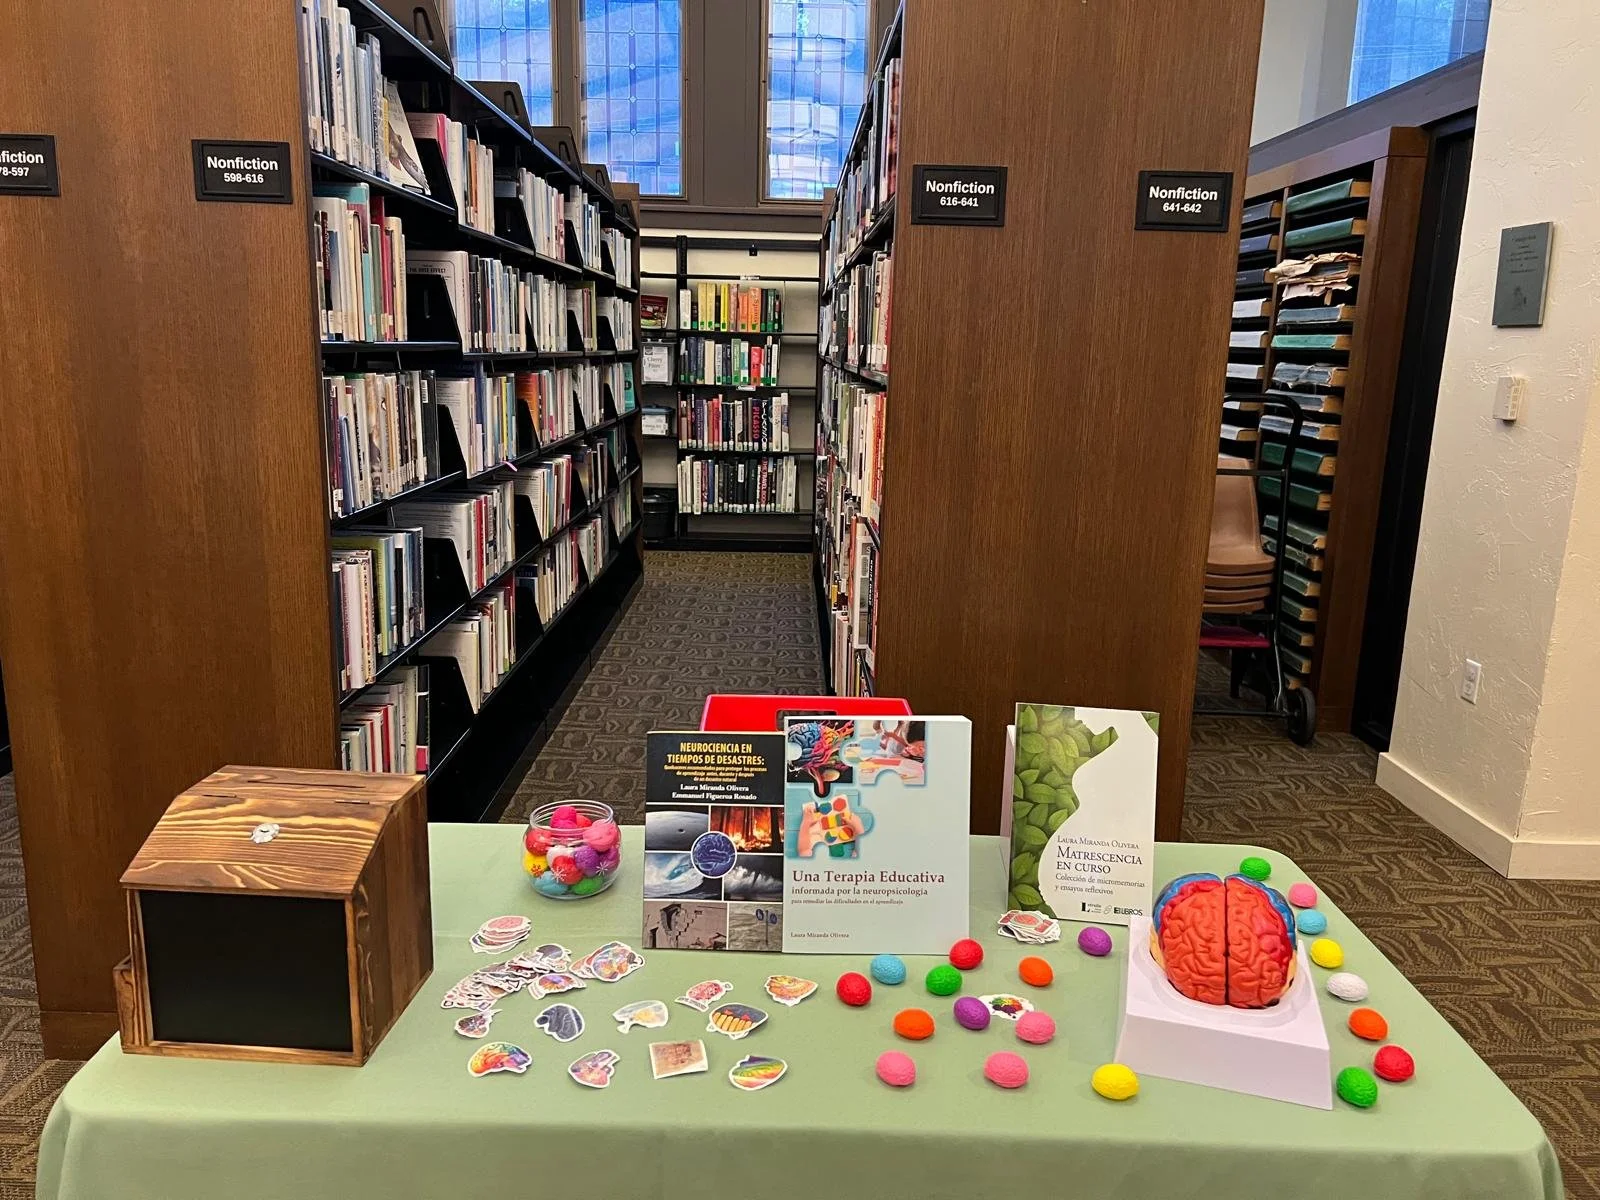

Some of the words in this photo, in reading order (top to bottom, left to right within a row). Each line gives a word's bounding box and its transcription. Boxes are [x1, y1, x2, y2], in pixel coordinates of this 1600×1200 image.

[0, 151, 44, 164] fiction
[207, 156, 278, 171] Nonfiction
[224, 172, 264, 184] 598-616
[926, 180, 994, 194] Nonfiction
[1149, 186, 1218, 201] Nonfiction
[940, 196, 978, 207] 616-641
[1162, 202, 1202, 213] 641-642
[680, 742, 740, 753] NEUROCIENCIA
[741, 744, 752, 754] EN
[667, 754, 703, 764] TIEMPOS
[705, 755, 715, 764] DE
[716, 755, 764, 765] DESASTRES:
[1056, 861, 1071, 870] EN
[1074, 863, 1111, 874] CURSO
[792, 870, 820, 882] Una
[824, 870, 875, 885] Terapia
[880, 871, 945, 883] Educativa
[1056, 873, 1086, 883] Colección
[1097, 878, 1145, 888] micromemorias
[1085, 886, 1114, 895] reflexivos
